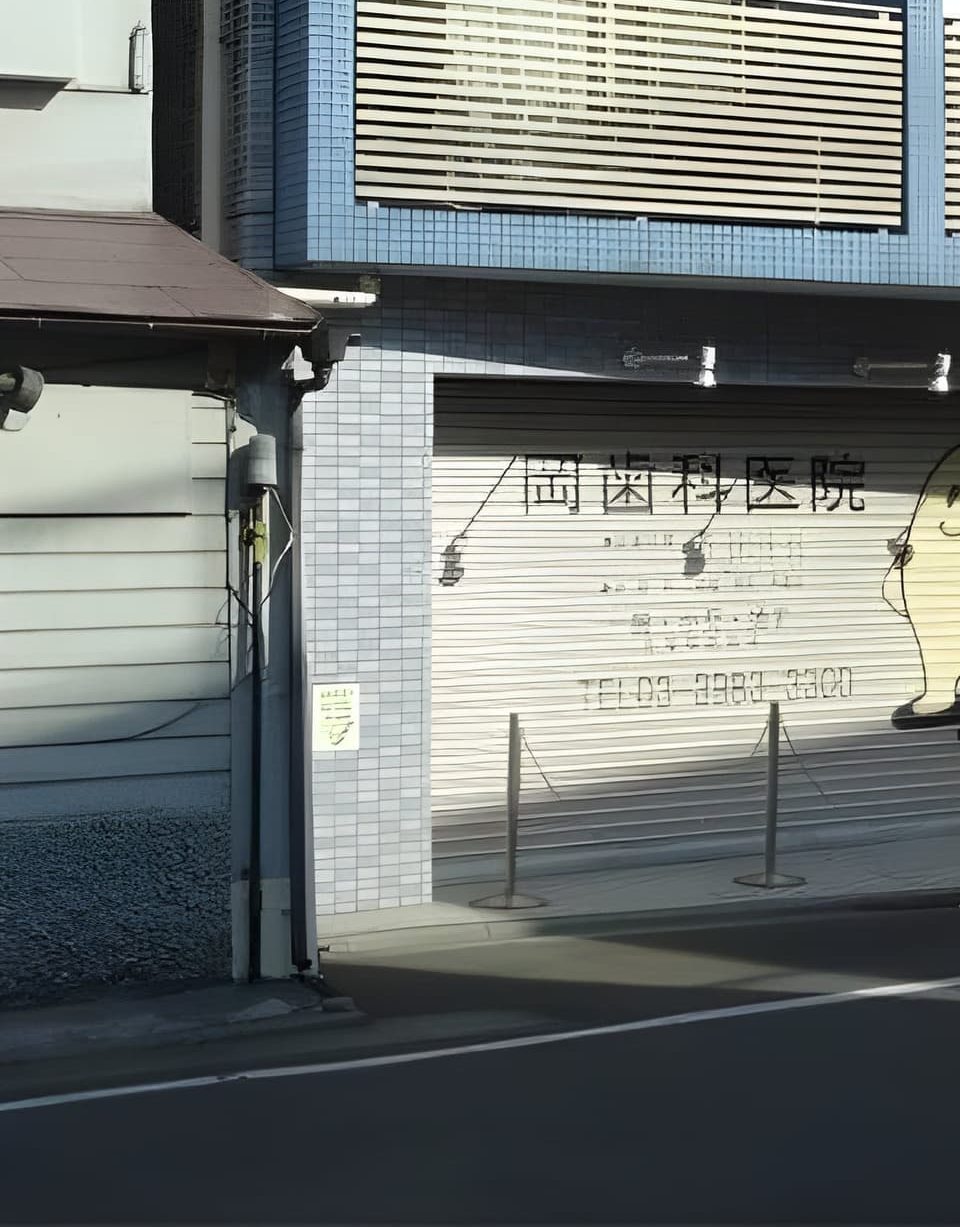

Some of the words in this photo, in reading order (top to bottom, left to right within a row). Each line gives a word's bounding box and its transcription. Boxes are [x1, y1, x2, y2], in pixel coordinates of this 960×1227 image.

[524, 452, 866, 515] 岡歯科医院
